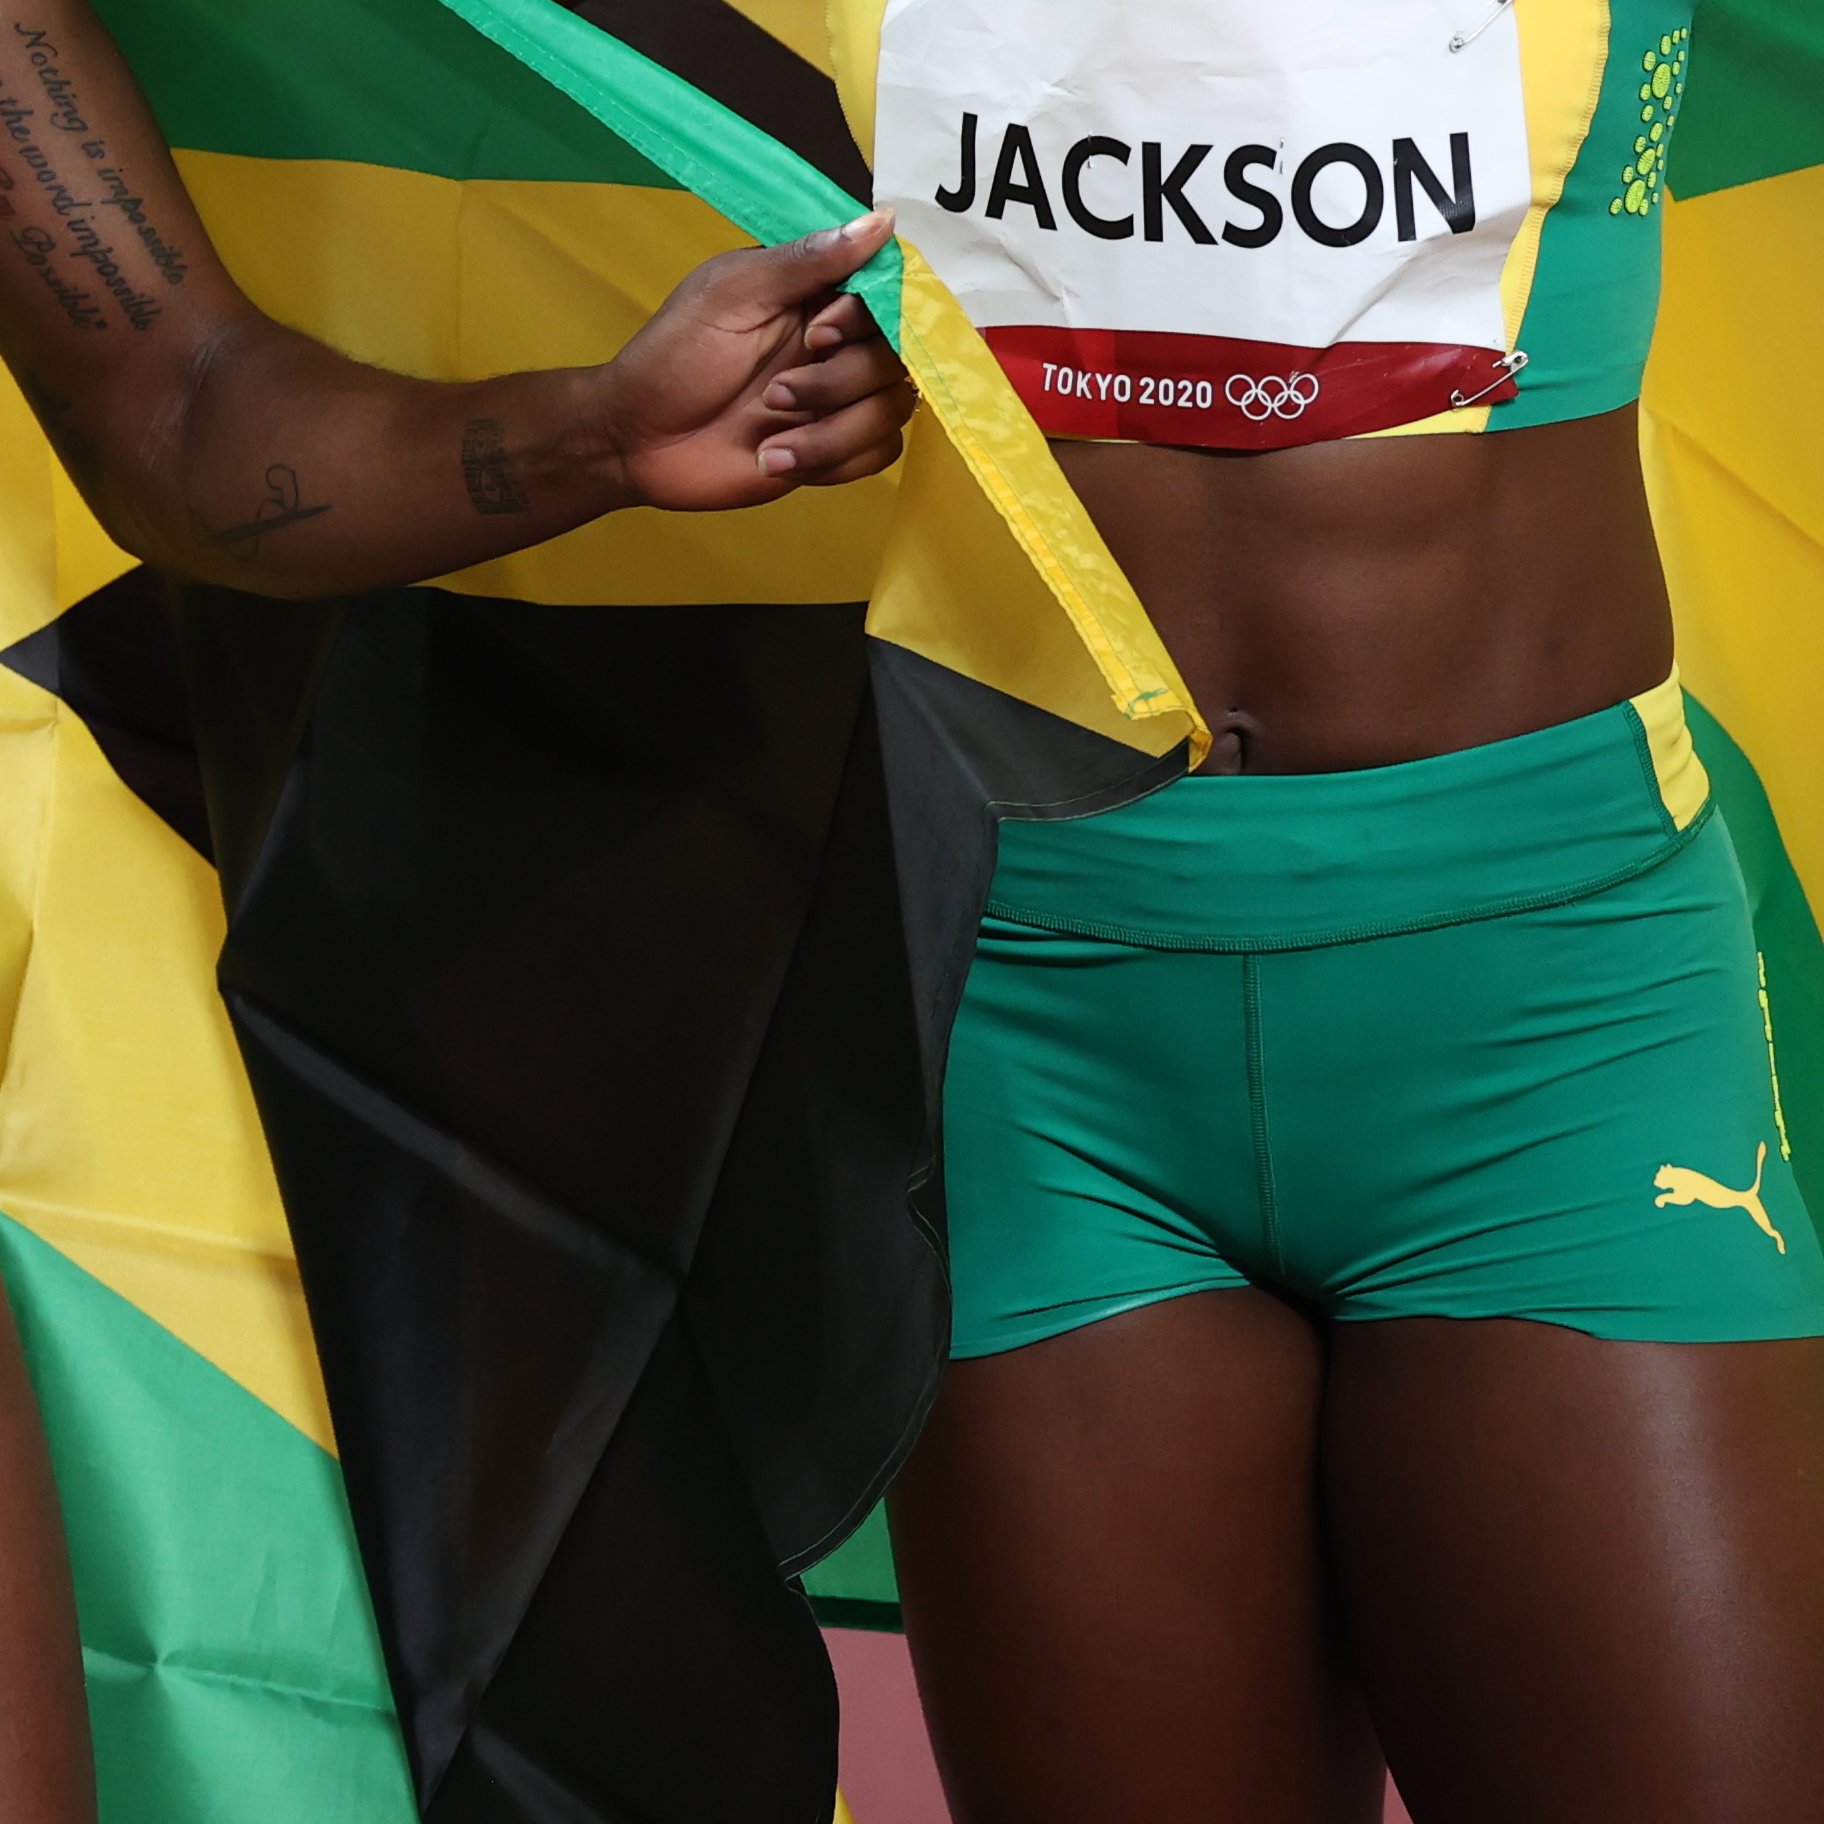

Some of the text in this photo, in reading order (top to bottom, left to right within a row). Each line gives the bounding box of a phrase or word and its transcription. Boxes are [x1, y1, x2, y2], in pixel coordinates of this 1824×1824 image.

[14, 23, 88, 133] Nothing
[82, 140, 106, 162] is
[19, 146, 92, 218] word
[67, 214, 162, 331] impossible
[934, 111, 1477, 249] JACKSON
[1042, 363, 1213, 409] TOKYO 2020
